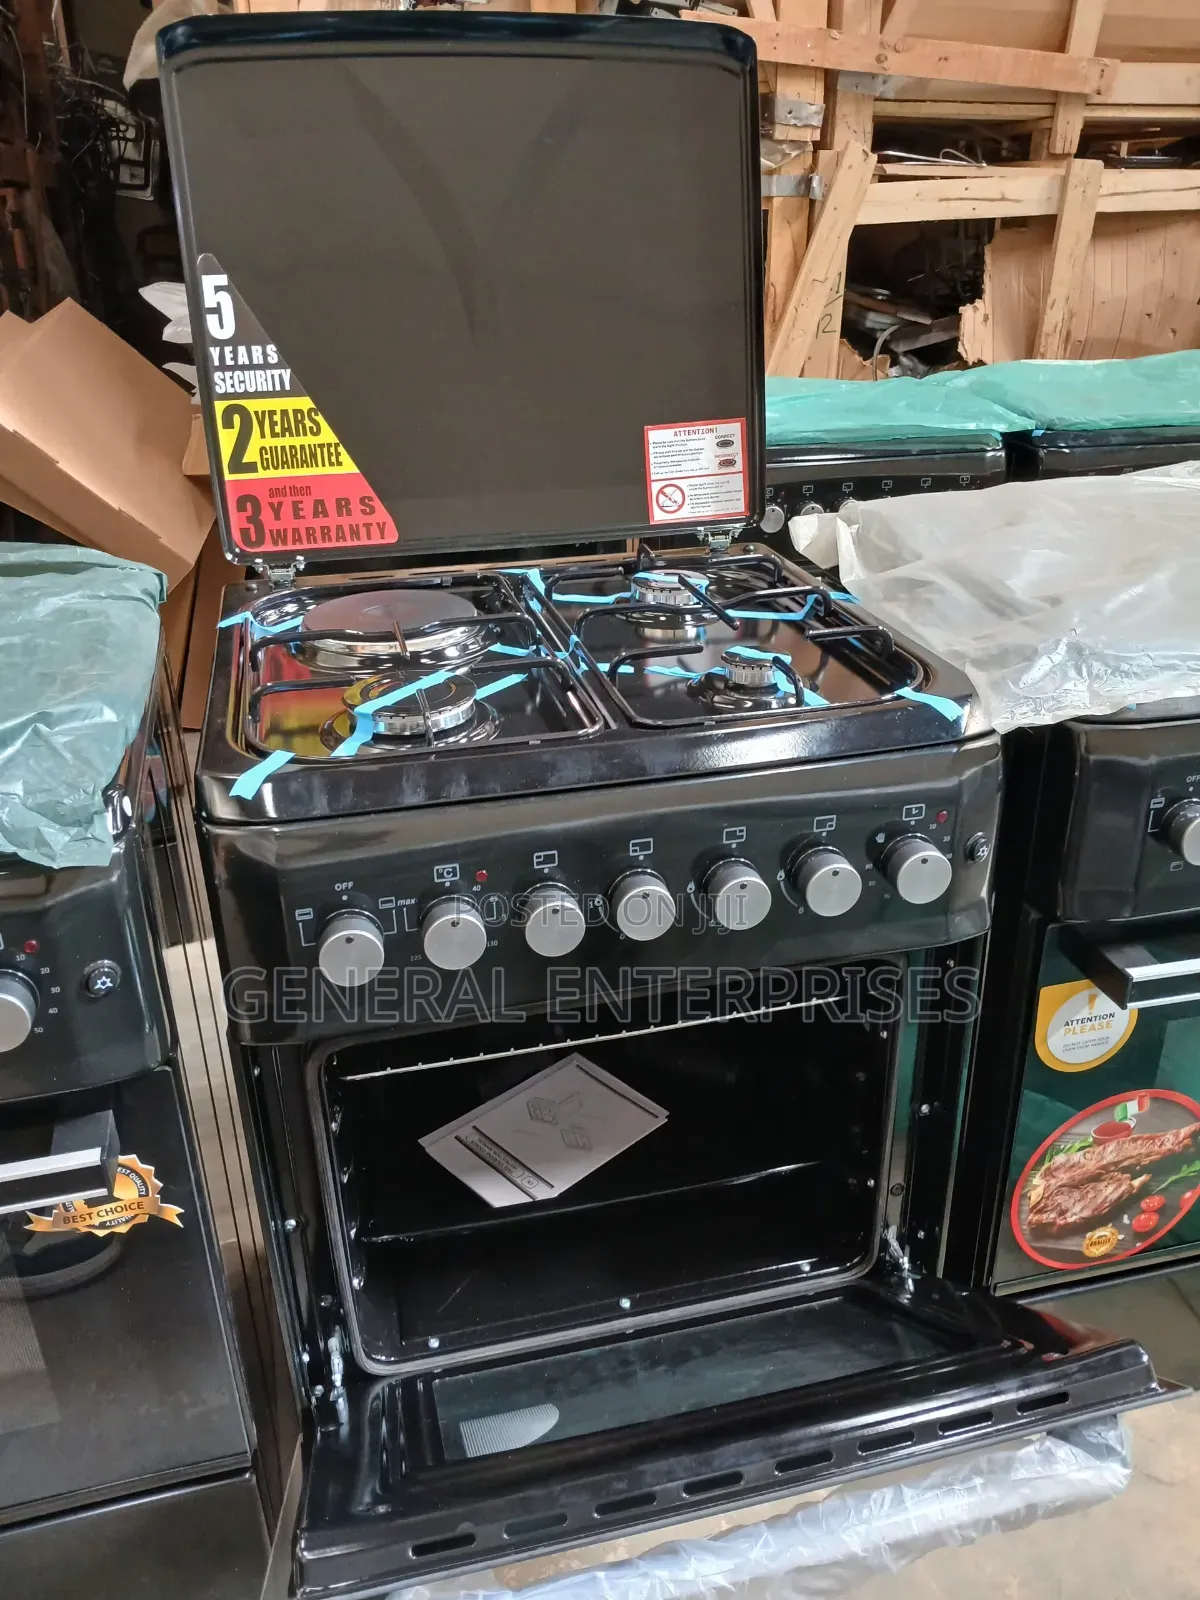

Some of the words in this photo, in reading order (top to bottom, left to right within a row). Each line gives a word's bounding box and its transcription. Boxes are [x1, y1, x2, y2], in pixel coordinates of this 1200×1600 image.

[201, 274, 236, 340] 5
[209, 343, 280, 367] YEARS
[213, 368, 292, 394] SECURITY
[221, 403, 259, 475] 2
[253, 406, 322, 440] YEARS
[673, 426, 718, 438] ATTENTION!
[258, 442, 343, 472] GUARANTEE
[268, 485, 287, 499] and
[288, 484, 312, 498] then
[235, 494, 266, 549] 3
[267, 494, 377, 522] YEARS
[268, 521, 388, 548] WARRANTY
[334, 881, 354, 892] OFF
[472, 884, 481, 892] 40
[397, 898, 416, 907] max
[40, 967, 50, 975] 20
[50, 986, 61, 994] 30
[1064, 1012, 1116, 1027] ATTENTION
[1063, 1020, 1113, 1037] PLEASE
[117, 1166, 131, 1175] EST
[63, 1212, 93, 1225] BEST
[96, 1201, 144, 1218] CHOICE
